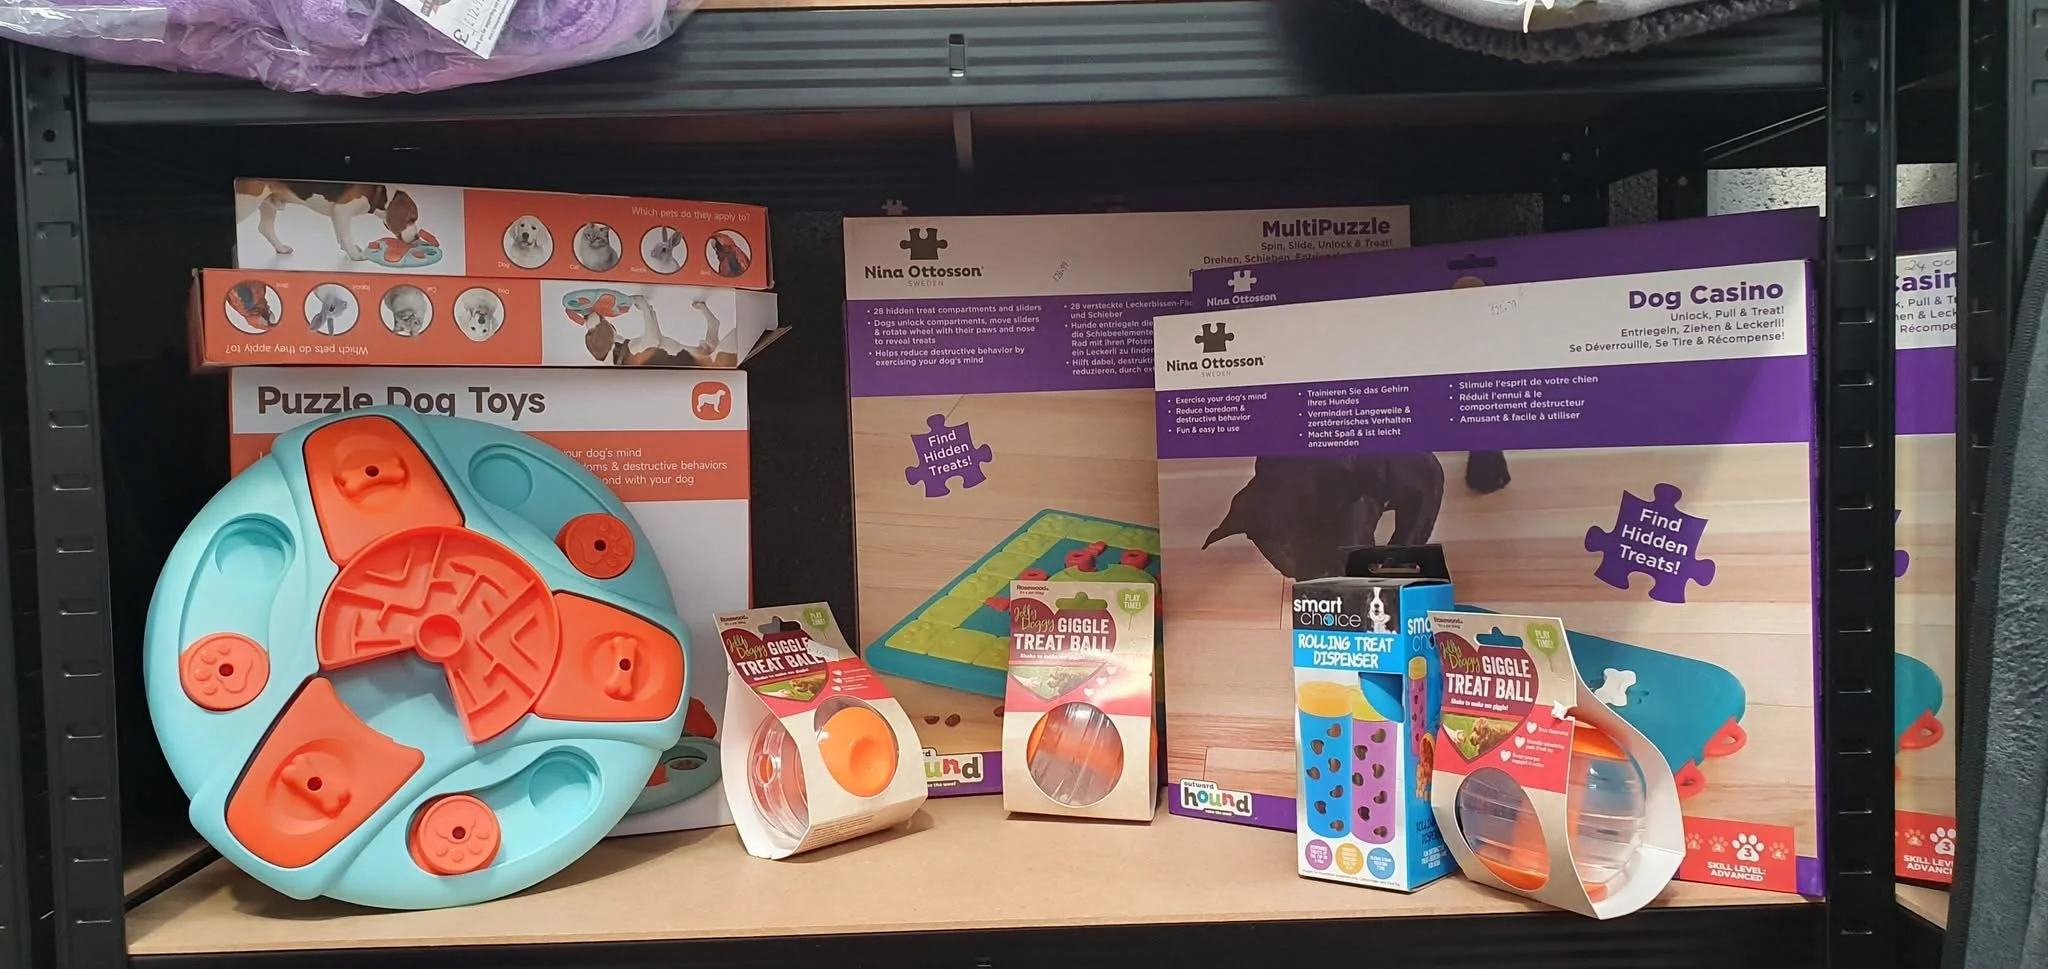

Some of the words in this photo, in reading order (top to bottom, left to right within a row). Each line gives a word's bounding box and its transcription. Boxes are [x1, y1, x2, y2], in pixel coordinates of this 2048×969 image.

[632, 206, 657, 216] Which
[660, 208, 678, 219] pets
[681, 208, 691, 217] do
[694, 209, 712, 220] they
[714, 211, 735, 222] apply
[738, 212, 750, 221] to?
[1262, 218, 1390, 237] MultiPuzzle
[1261, 241, 1285, 251] Spin,
[1288, 240, 1315, 250] Slide,
[1318, 239, 1351, 248] Unlock
[1365, 238, 1392, 247] Treat!
[1204, 256, 1242, 265] Drehen,
[1245, 254, 1291, 263] Schieben,
[865, 266, 904, 279] Nina
[908, 265, 982, 278] Ottosson
[1896, 270, 1957, 292] asin
[1207, 297, 1230, 307] Nina
[1232, 293, 1277, 305] Ottosson
[1629, 289, 1681, 310] Dog
[1690, 281, 1784, 305] Casino
[1909, 297, 1930, 306] Pull
[938, 305, 996, 315] compartments
[1670, 310, 1712, 322] Unlock,
[1715, 308, 1736, 319] Pull
[1752, 305, 1785, 316] Treat!
[874, 319, 895, 328] Dogs
[898, 318, 924, 326] unlock
[927, 317, 988, 327] compartments,
[1621, 326, 1680, 337] Entriegeln,
[1683, 323, 1721, 334] Ziehen
[1736, 319, 1785, 330] Leckerli!
[1569, 344, 1582, 352] Se
[1585, 338, 1652, 352] Déverrouille,
[1655, 339, 1669, 348] Se
[1672, 337, 1693, 347] Tire
[1708, 331, 1785, 345] Récompense!
[244, 344, 271, 354] apply
[274, 344, 295, 354] they
[315, 345, 335, 355] pets
[339, 346, 368, 355] Which
[875, 349, 898, 359] Helps
[930, 347, 975, 356] destructive
[876, 358, 916, 366] exercising
[939, 356, 961, 365] dog's
[1166, 360, 1198, 372] Nina
[1201, 356, 1264, 369] Ottosson
[1072, 367, 1117, 376] reduzieren,
[1459, 381, 1493, 389] Stimule
[1496, 379, 1527, 388] l'esprit
[1572, 375, 1598, 384] chien
[1307, 388, 1347, 397] Trainieren
[1381, 385, 1409, 394] Gehirn
[1460, 392, 1488, 401] Réduit
[1491, 391, 1522, 399] l'ennui
[258, 386, 373, 414] Puzzle
[387, 386, 456, 417] Dog
[468, 386, 546, 421] Toys
[1176, 396, 1206, 404] Exercise
[1226, 394, 1246, 402] dog's
[1248, 393, 1267, 401] mind
[1307, 398, 1327, 407] Ihres
[1329, 397, 1359, 405] Hundes
[1176, 406, 1203, 415] Reduce
[1204, 405, 1238, 414] boredom
[1308, 408, 1352, 418] Vermindert
[1355, 407, 1403, 417] Langeweile
[1460, 402, 1527, 412] comportement
[1530, 400, 1585, 408] destructeur
[1176, 415, 1217, 424] destructive
[1218, 413, 1251, 422] behavior
[1308, 417, 1369, 427] zerstörerisches
[1372, 416, 1412, 424] Verhalten
[1460, 415, 1500, 423] Amusant
[1512, 412, 1536, 421] facile
[1548, 411, 1580, 419] utiliser
[928, 430, 957, 447] Find
[1308, 430, 1332, 438] Macht
[1308, 439, 1359, 448] anzuwenden
[586, 448, 613, 460] dog's
[616, 448, 642, 457] mind
[924, 443, 969, 463] Hidden
[584, 462, 608, 472] oms
[623, 461, 678, 471] destructive
[681, 460, 728, 470] behaviors
[928, 455, 973, 476] Treats!
[601, 475, 621, 485] ond
[625, 474, 647, 484] with
[649, 477, 672, 486] your
[676, 474, 694, 486] dog
[1640, 508, 1682, 532] Find
[1621, 524, 1688, 556] Hidden
[1620, 544, 1681, 575] Treats!
[1294, 597, 1342, 613] smart
[1021, 617, 1055, 632] Doggy
[1058, 618, 1109, 634] GIGGLE
[1300, 611, 1361, 628] choice
[1535, 630, 1550, 639] PLAY
[1014, 634, 1065, 651] TREAT
[1070, 635, 1111, 653] BALL
[1298, 634, 1350, 650] ROLLING
[1354, 637, 1394, 653] TREAT
[737, 644, 768, 659] Doggy
[737, 659, 785, 676] TREAT
[785, 652, 825, 668] BALL
[1314, 651, 1379, 669] DISPENSER
[1450, 655, 1480, 673] Doggy
[1482, 656, 1531, 678] GIGGLE
[1446, 673, 1491, 697] TREAT
[1496, 678, 1533, 702] BALL
[1184, 787, 1250, 813] hound
[1744, 848, 1752, 858] 3
[1943, 842, 1951, 851] 3
[1904, 854, 1931, 864] SKILL
[1707, 861, 1733, 871] SKILL
[1735, 865, 1766, 875] LEVEL:
[1711, 869, 1763, 882] ADVANCED
